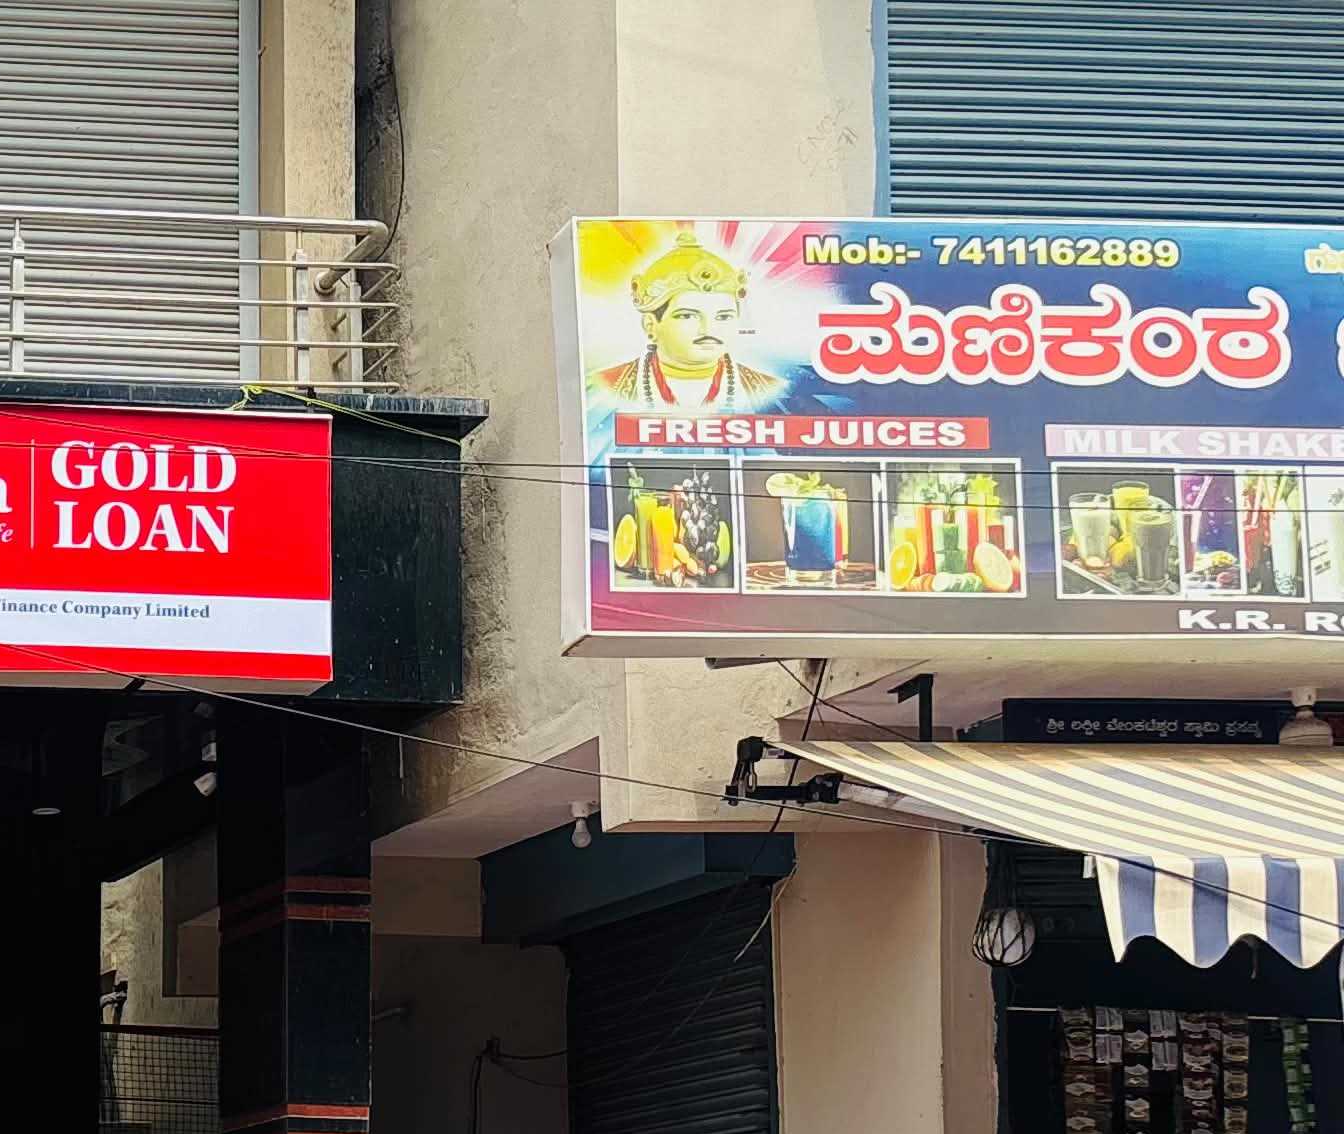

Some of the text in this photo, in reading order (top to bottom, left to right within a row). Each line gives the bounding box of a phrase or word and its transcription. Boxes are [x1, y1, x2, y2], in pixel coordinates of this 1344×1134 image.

[804, 235, 1180, 268] Mob:- 7411162889
[814, 285, 1290, 386] ಮಣಿಕಂಠ
[637, 420, 967, 447] FRESH JUICES
[1062, 428, 1181, 456] MILK
[50, 440, 238, 494] GOLD
[52, 501, 235, 554] LOAN
[61, 600, 141, 619] Company
[145, 602, 210, 619] Limited
[1178, 609, 1286, 631] K.R.
